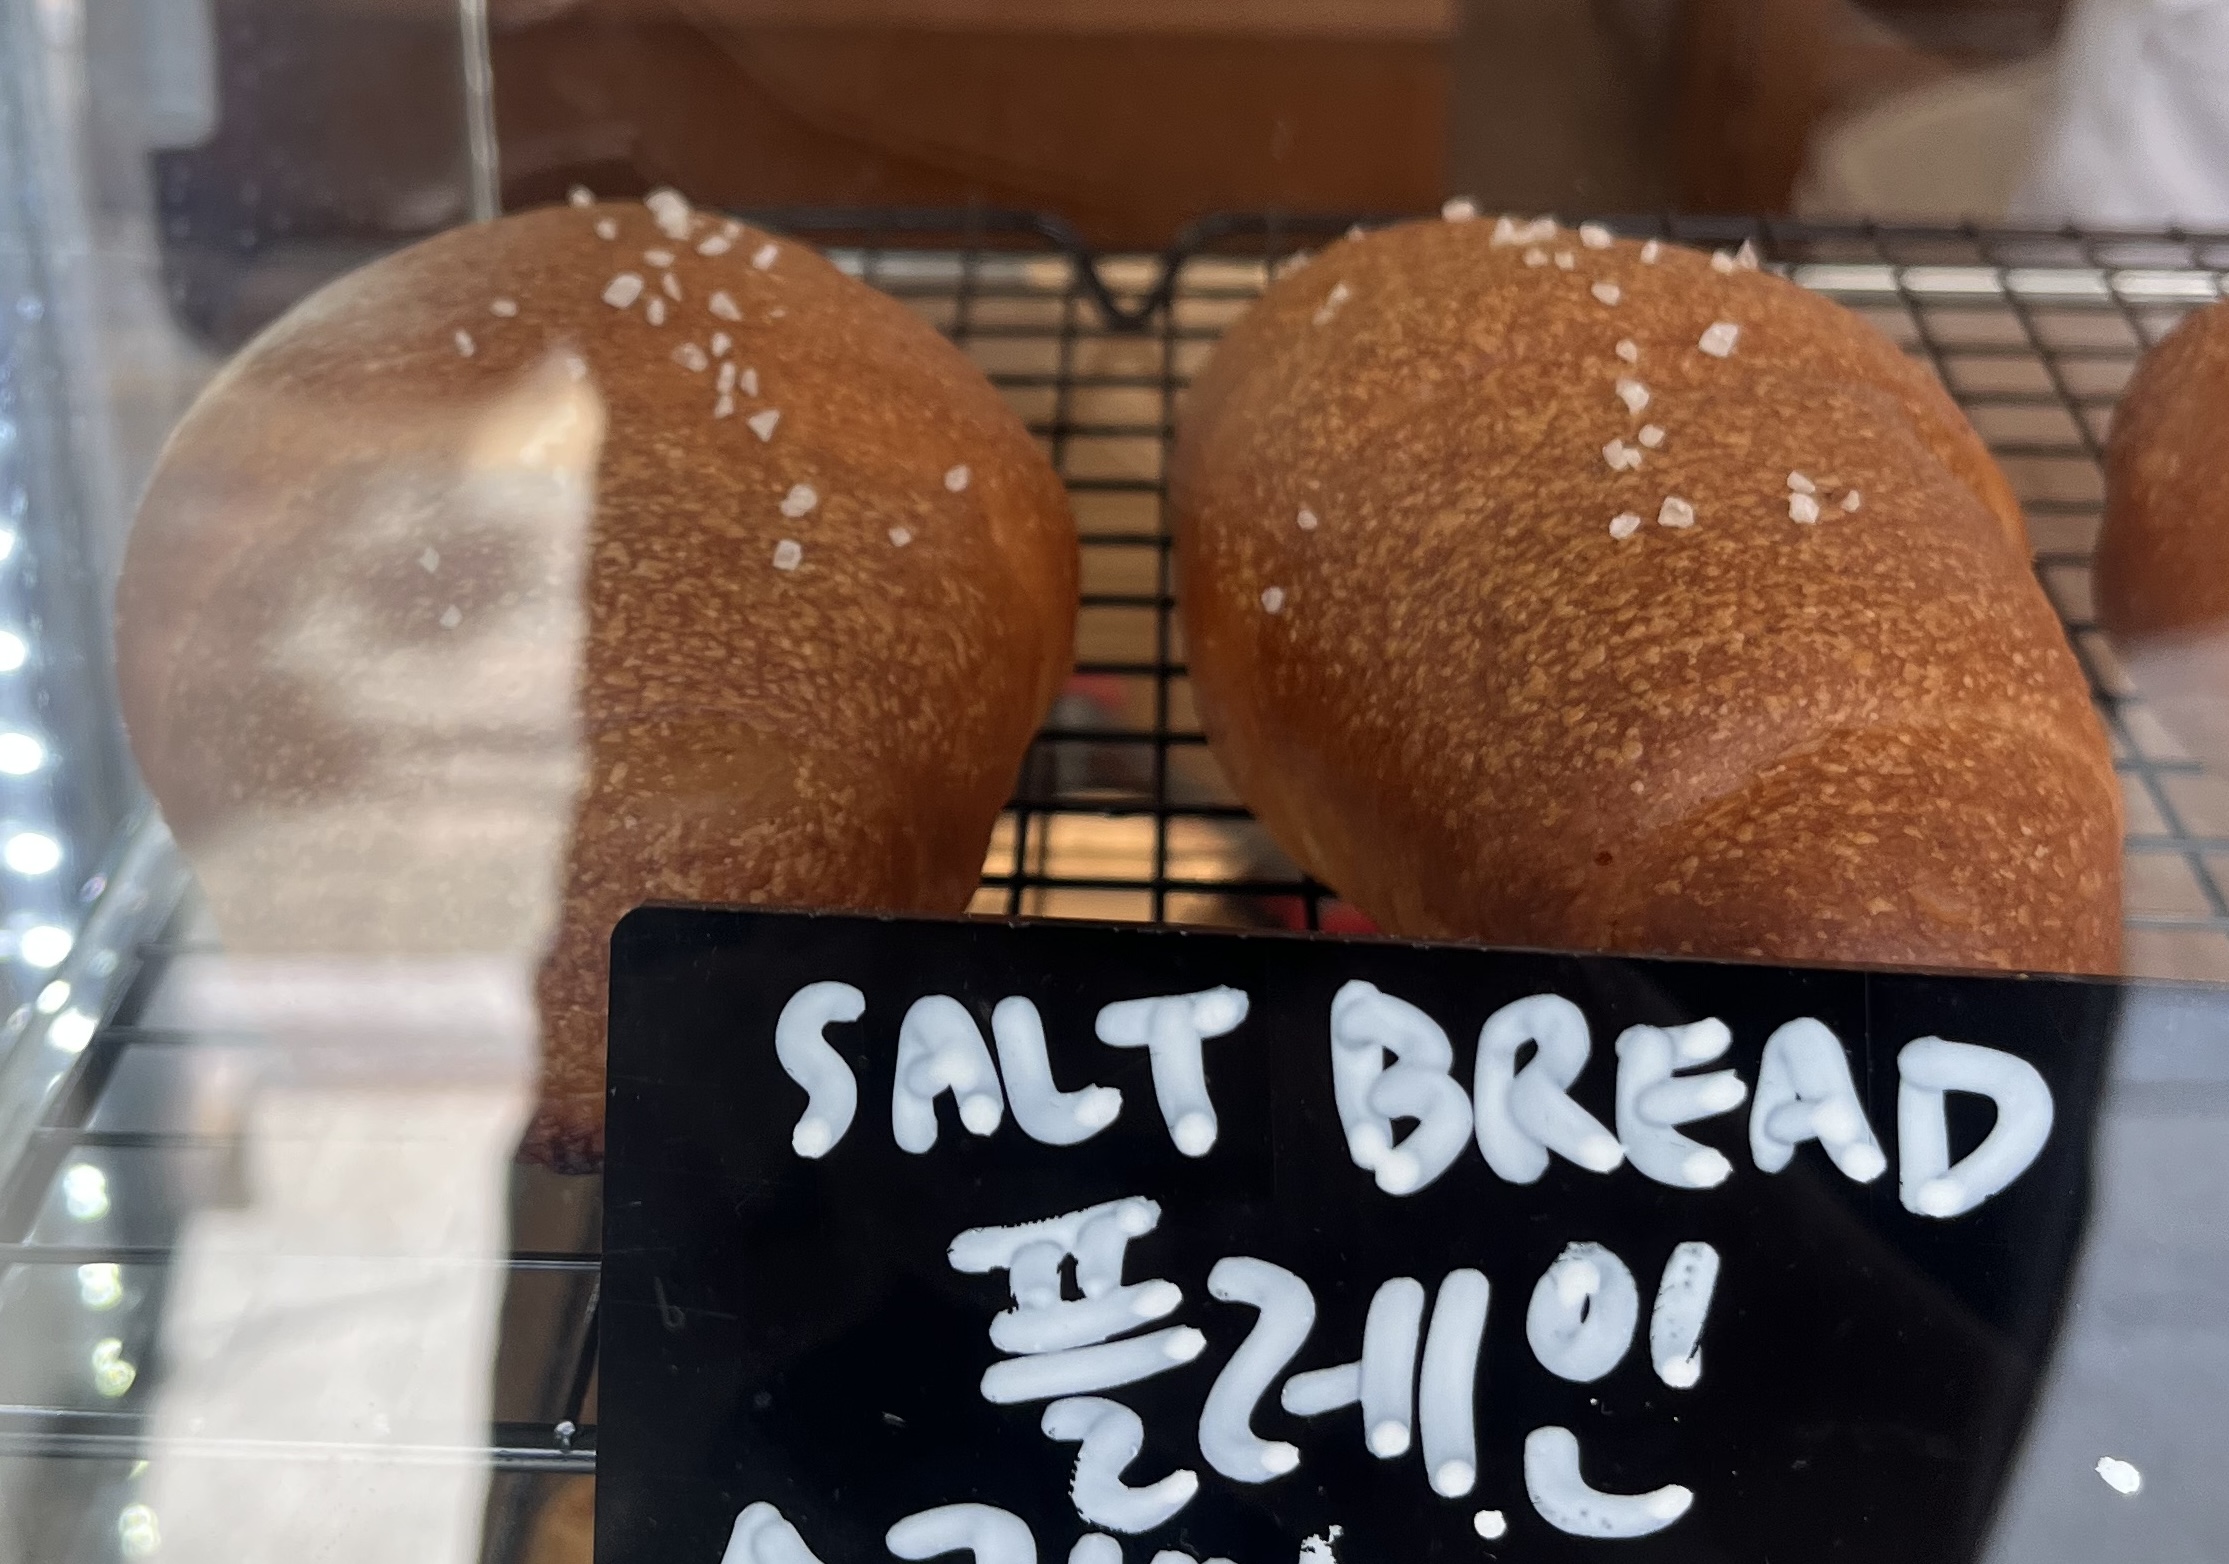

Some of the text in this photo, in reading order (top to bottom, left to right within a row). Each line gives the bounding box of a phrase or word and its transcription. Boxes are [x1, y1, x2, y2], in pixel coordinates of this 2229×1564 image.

[775, 979, 2054, 1219] SALT BREAD
[947, 1195, 1720, 1539] 플레인
